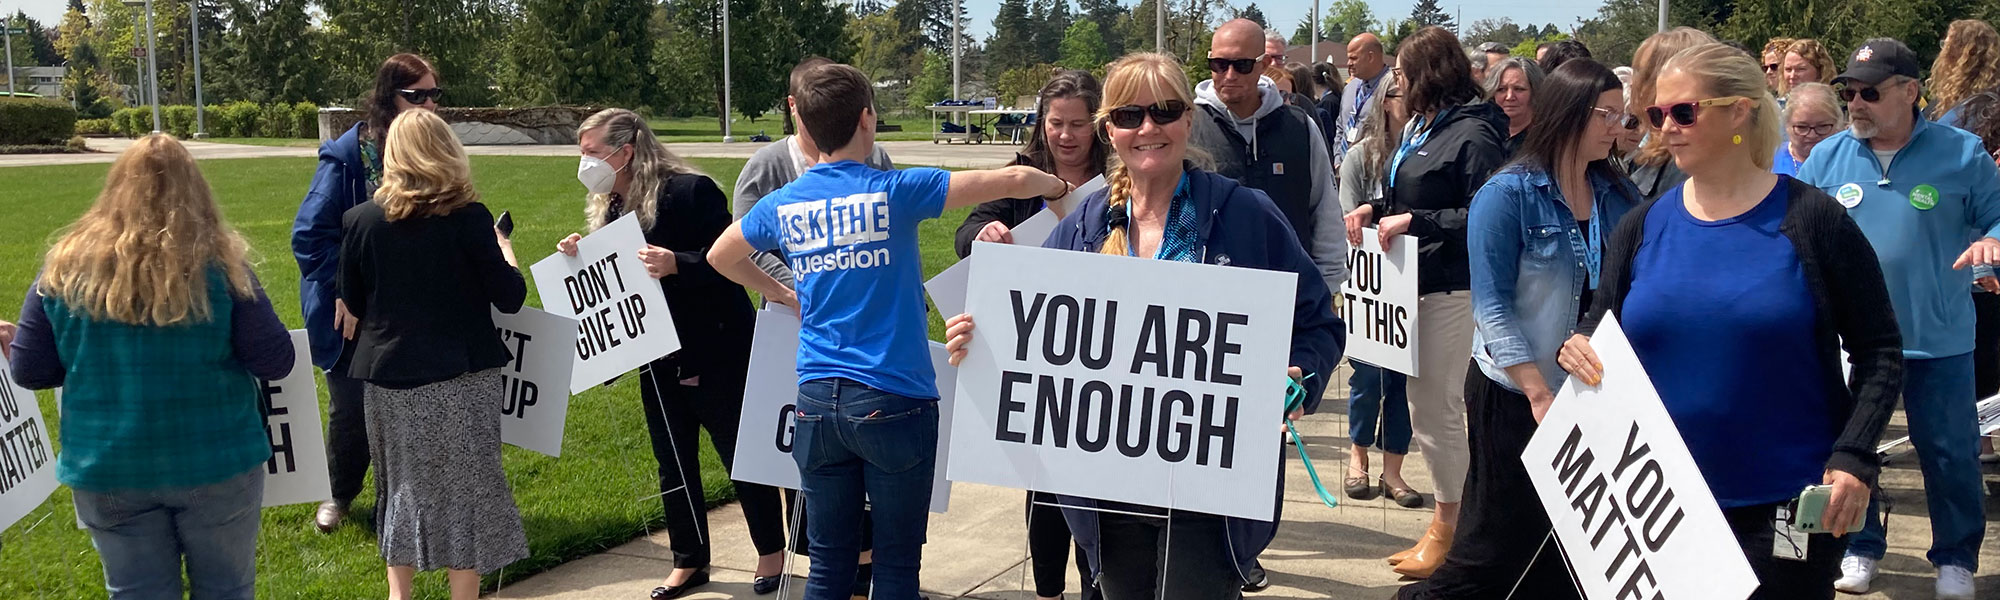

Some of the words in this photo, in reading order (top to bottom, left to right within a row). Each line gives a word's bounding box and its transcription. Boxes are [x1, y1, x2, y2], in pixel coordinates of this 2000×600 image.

[781, 208, 825, 246] ASK
[833, 201, 888, 237] THE
[564, 252, 625, 316] DON'T
[792, 245, 890, 281] question
[1346, 249, 1381, 295] YOU
[617, 294, 646, 339] UP
[1009, 290, 1118, 370] YOU
[1130, 304, 1249, 386] ARE
[1362, 297, 1407, 349] THIS
[502, 374, 539, 419] UP
[995, 370, 1239, 469] ENOUGH
[1551, 423, 1665, 600] MATTE
[1612, 419, 1685, 553] YOU
